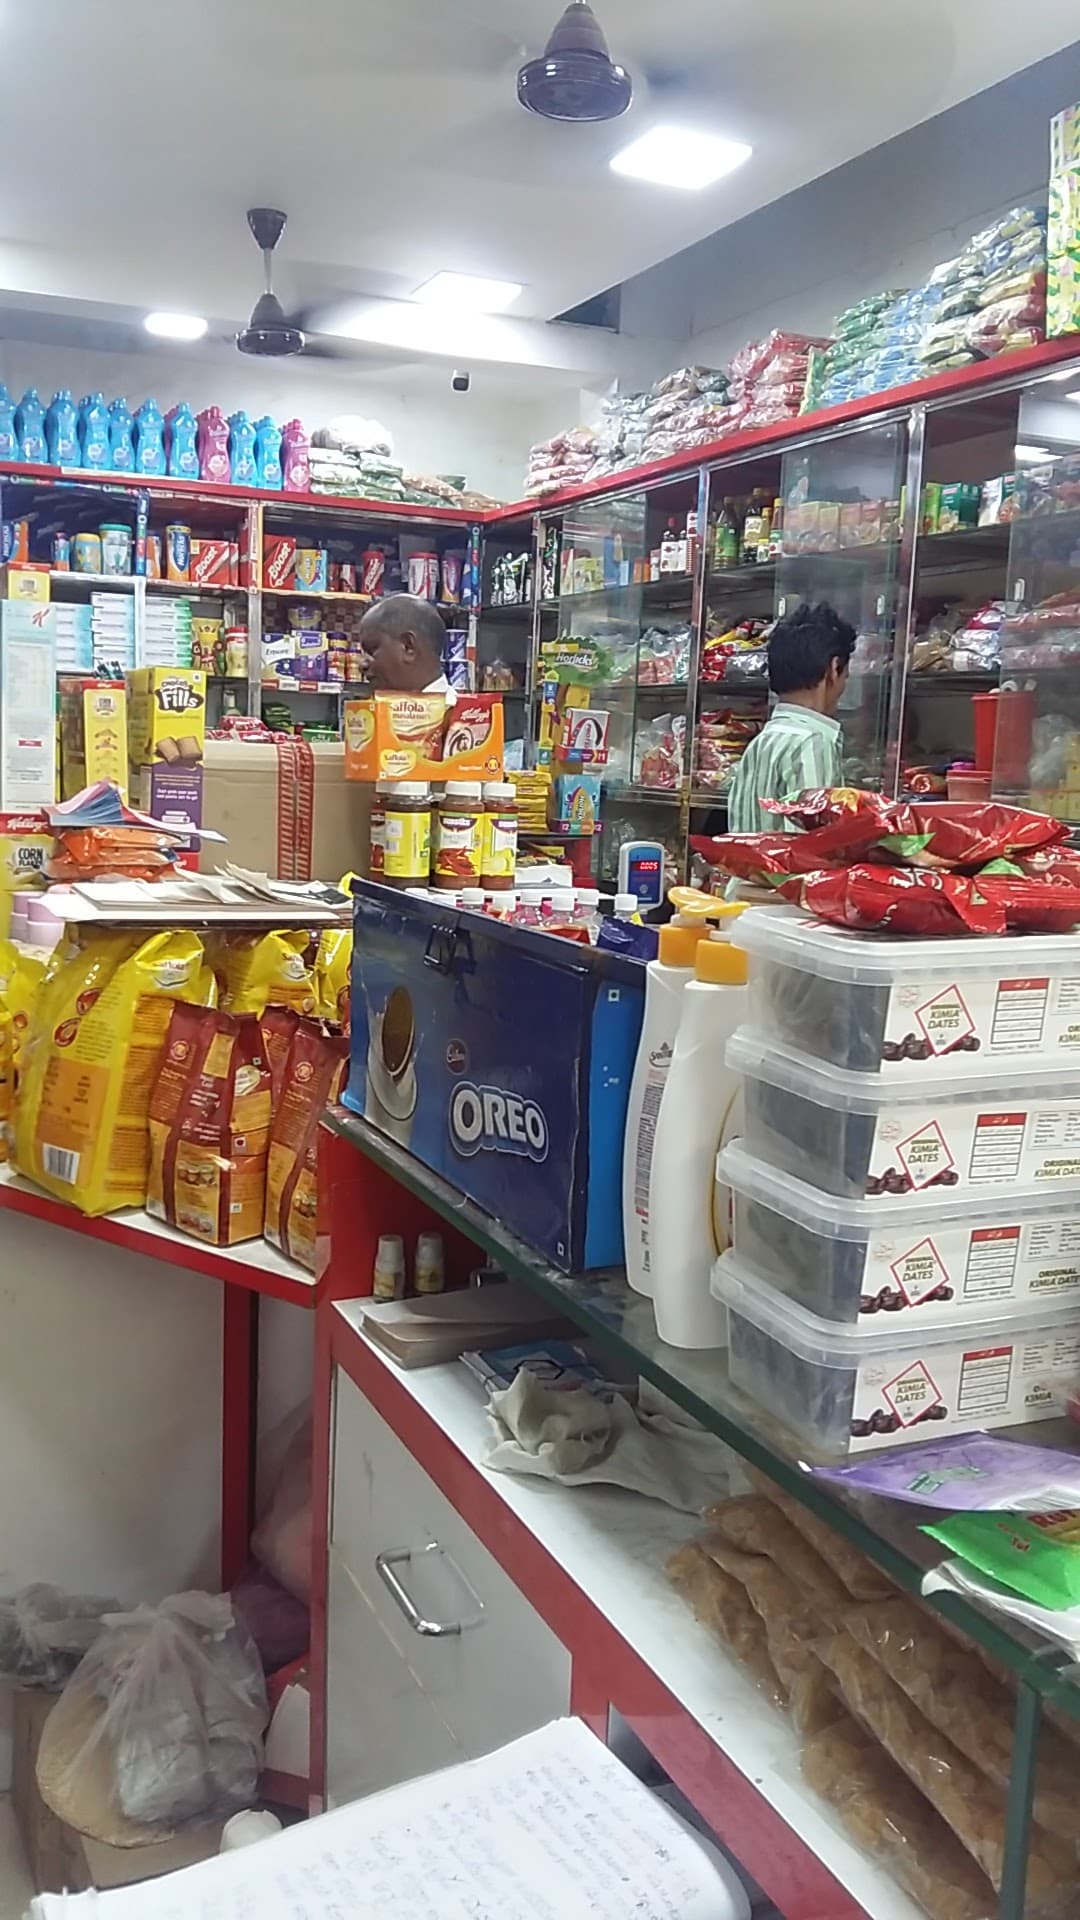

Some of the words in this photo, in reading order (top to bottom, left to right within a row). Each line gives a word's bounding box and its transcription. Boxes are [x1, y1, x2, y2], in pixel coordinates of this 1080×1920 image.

[162, 689, 199, 710] Fills
[18, 847, 44, 862] CORN
[930, 1010, 960, 1019] KIMIA
[927, 1018, 961, 1029] DATES
[453, 1088, 545, 1149] OREO
[910, 1144, 940, 1153] KIMIA
[907, 1153, 940, 1164] DATES
[905, 1262, 934, 1271] KIMIA
[902, 1271, 934, 1282] DATES
[897, 1383, 926, 1394] KIMIA
[895, 1391, 926, 1404] DATES
